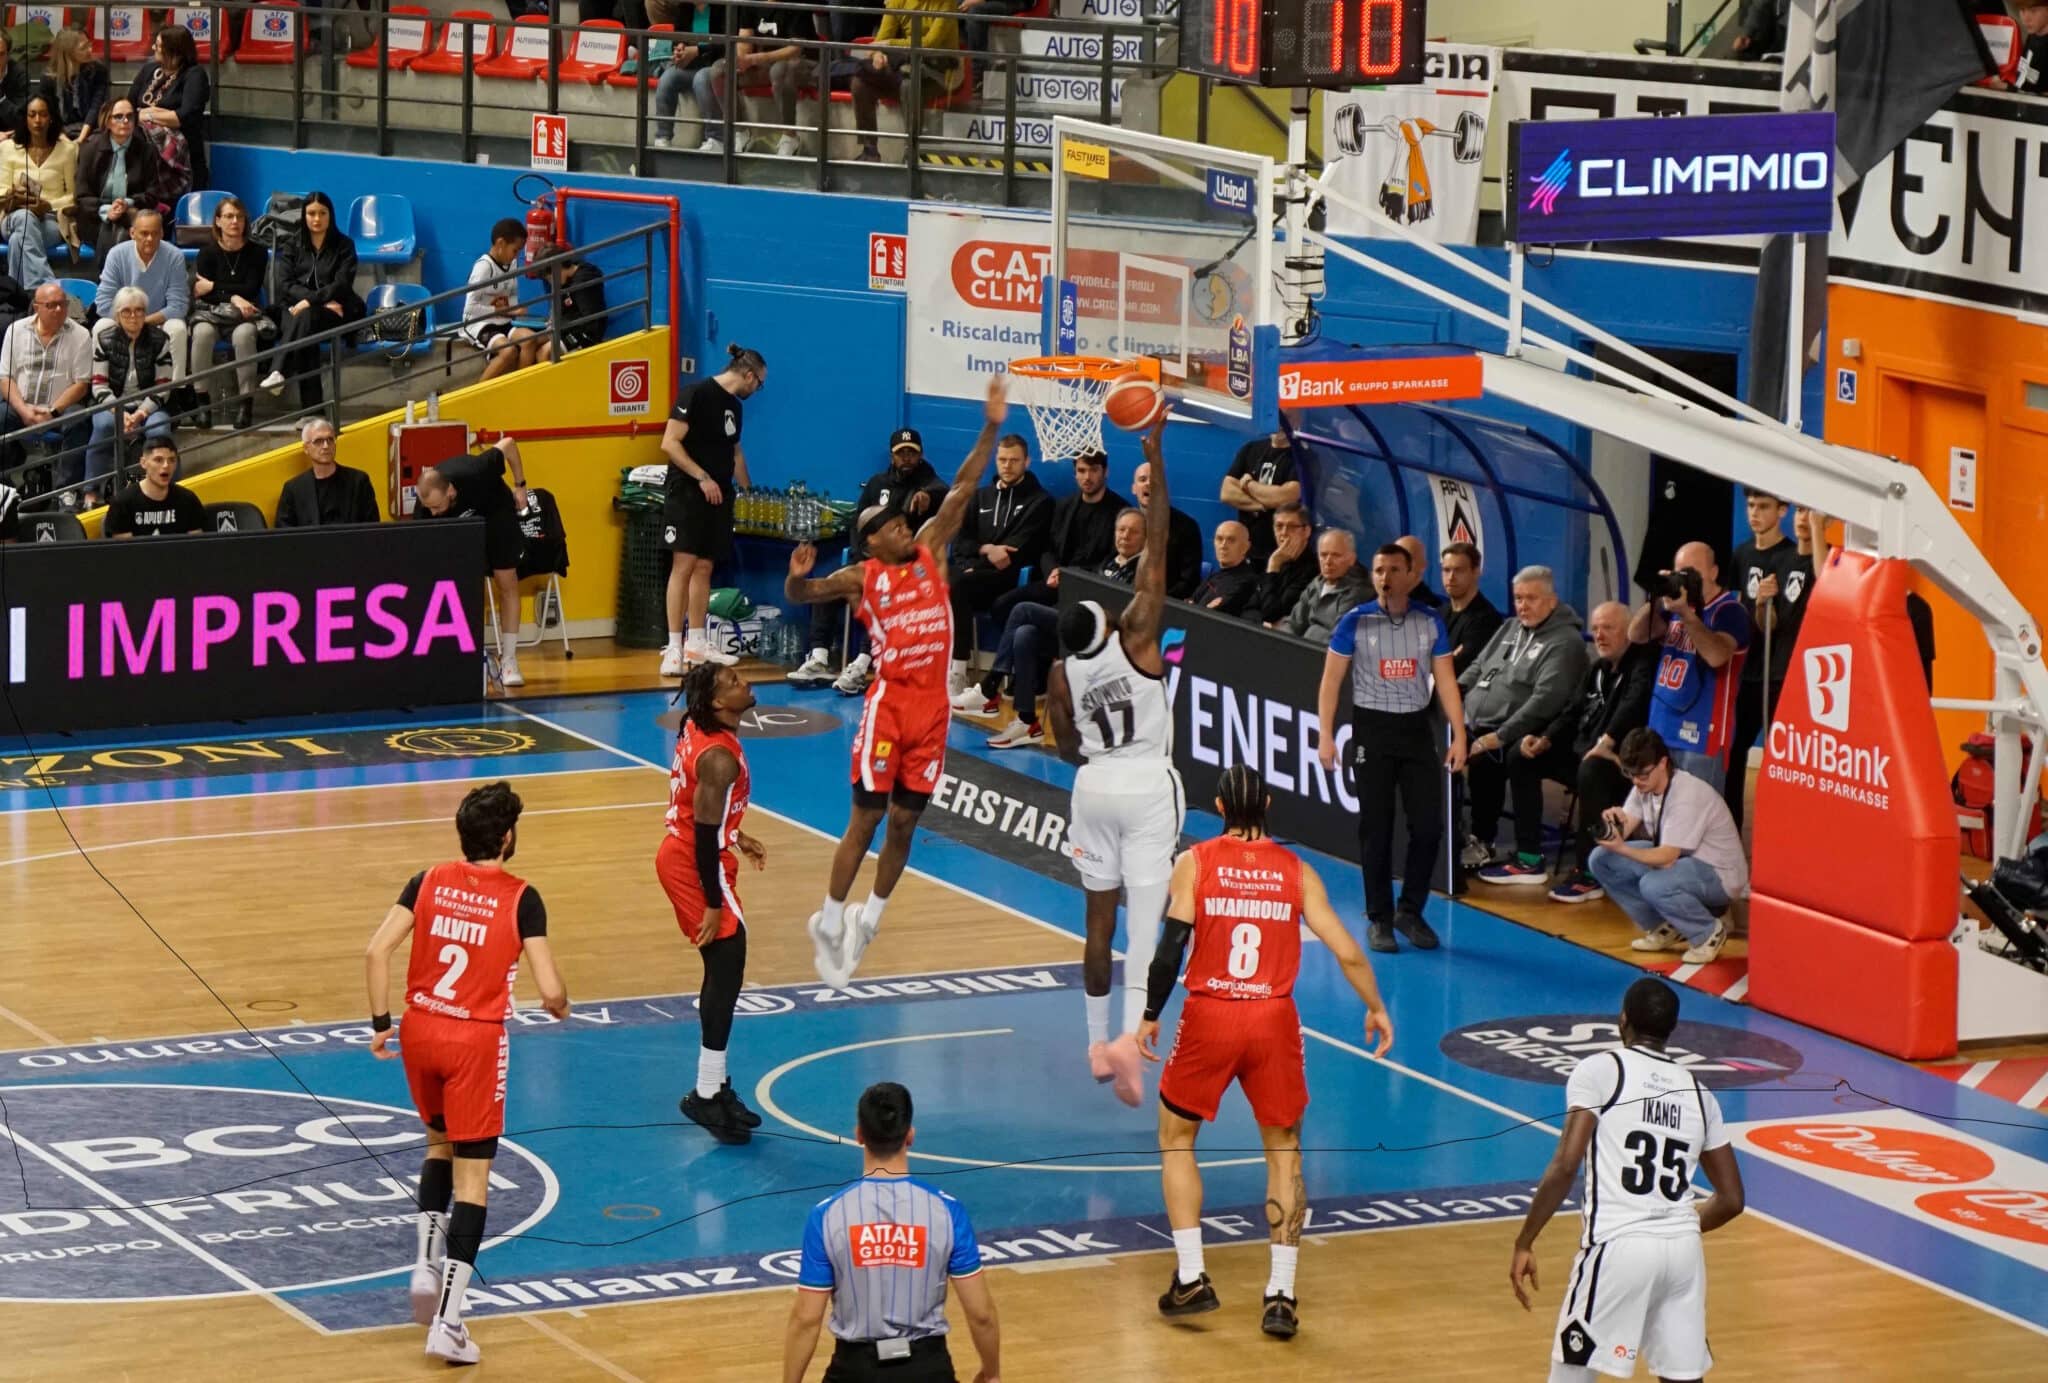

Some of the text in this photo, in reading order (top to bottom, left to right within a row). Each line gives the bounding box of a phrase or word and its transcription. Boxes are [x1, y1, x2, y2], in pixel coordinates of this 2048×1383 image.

[533, 157, 565, 167] ESTINTORE
[1579, 151, 1828, 198] CLIMAMIO
[1216, 175, 1248, 206] Unipol
[871, 278, 905, 288] ESTINTORE
[1060, 327, 1075, 340] FIP
[1230, 346, 1249, 364] LBA
[1300, 377, 1449, 397] Bank GRUPPO SPARKASSE
[613, 404, 646, 414] IDRANTE
[875, 570, 891, 593] 4
[67, 579, 477, 681] IMPRESA
[1383, 659, 1413, 670] ATTAL
[1658, 655, 1690, 690] 10
[1088, 699, 1134, 749] 17
[923, 759, 939, 782] 4
[1769, 721, 1891, 789] CiviBank
[1767, 764, 1890, 811] GRUPPO SPARKASSE
[430, 914, 488, 947] ALVITI
[1228, 922, 1262, 980] 8
[432, 943, 469, 1000] 2
[1641, 1097, 1682, 1130] IKANGI
[48, 1115, 428, 1172] BCC
[1621, 1130, 1690, 1202] 35
[197, 1226, 295, 1244] BCC
[859, 1224, 919, 1246] ATTAL
[859, 1244, 919, 1259] GROUP
[458, 1266, 757, 1312] Allianz
